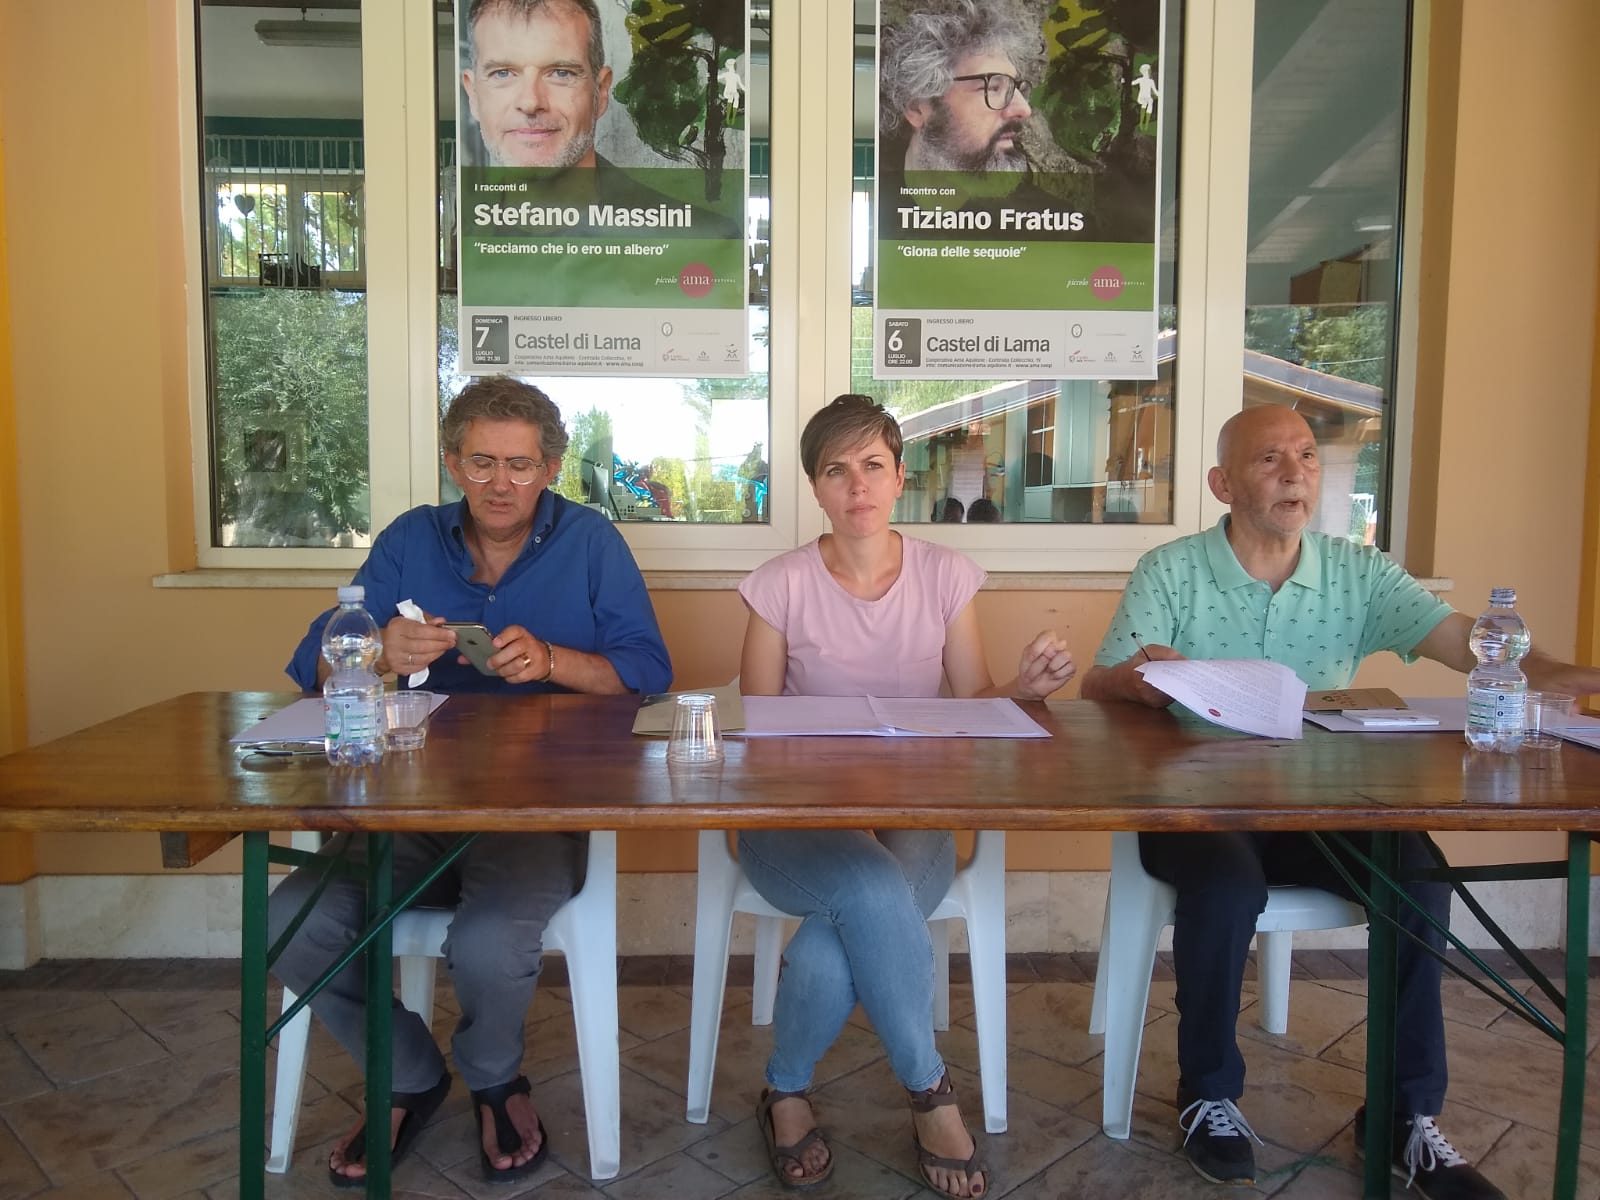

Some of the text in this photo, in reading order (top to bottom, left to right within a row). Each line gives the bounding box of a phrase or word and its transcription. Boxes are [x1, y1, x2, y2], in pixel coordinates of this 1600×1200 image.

[480, 183, 517, 192] racconti
[518, 183, 528, 192] di
[900, 187, 956, 196] Incontro con
[474, 202, 692, 228] Stefano Massini
[897, 206, 1085, 231] Tiziano Fratus
[541, 243, 564, 254] che
[566, 243, 579, 255] io
[581, 245, 602, 255] ero
[605, 245, 621, 255] un
[940, 246, 971, 258] delle
[683, 274, 710, 286] ama
[1094, 278, 1120, 289] ama
[475, 326, 490, 348] 7
[514, 333, 641, 351] Castel di Lama
[888, 329, 903, 352] 6
[926, 335, 1050, 352] Castel di Lama
